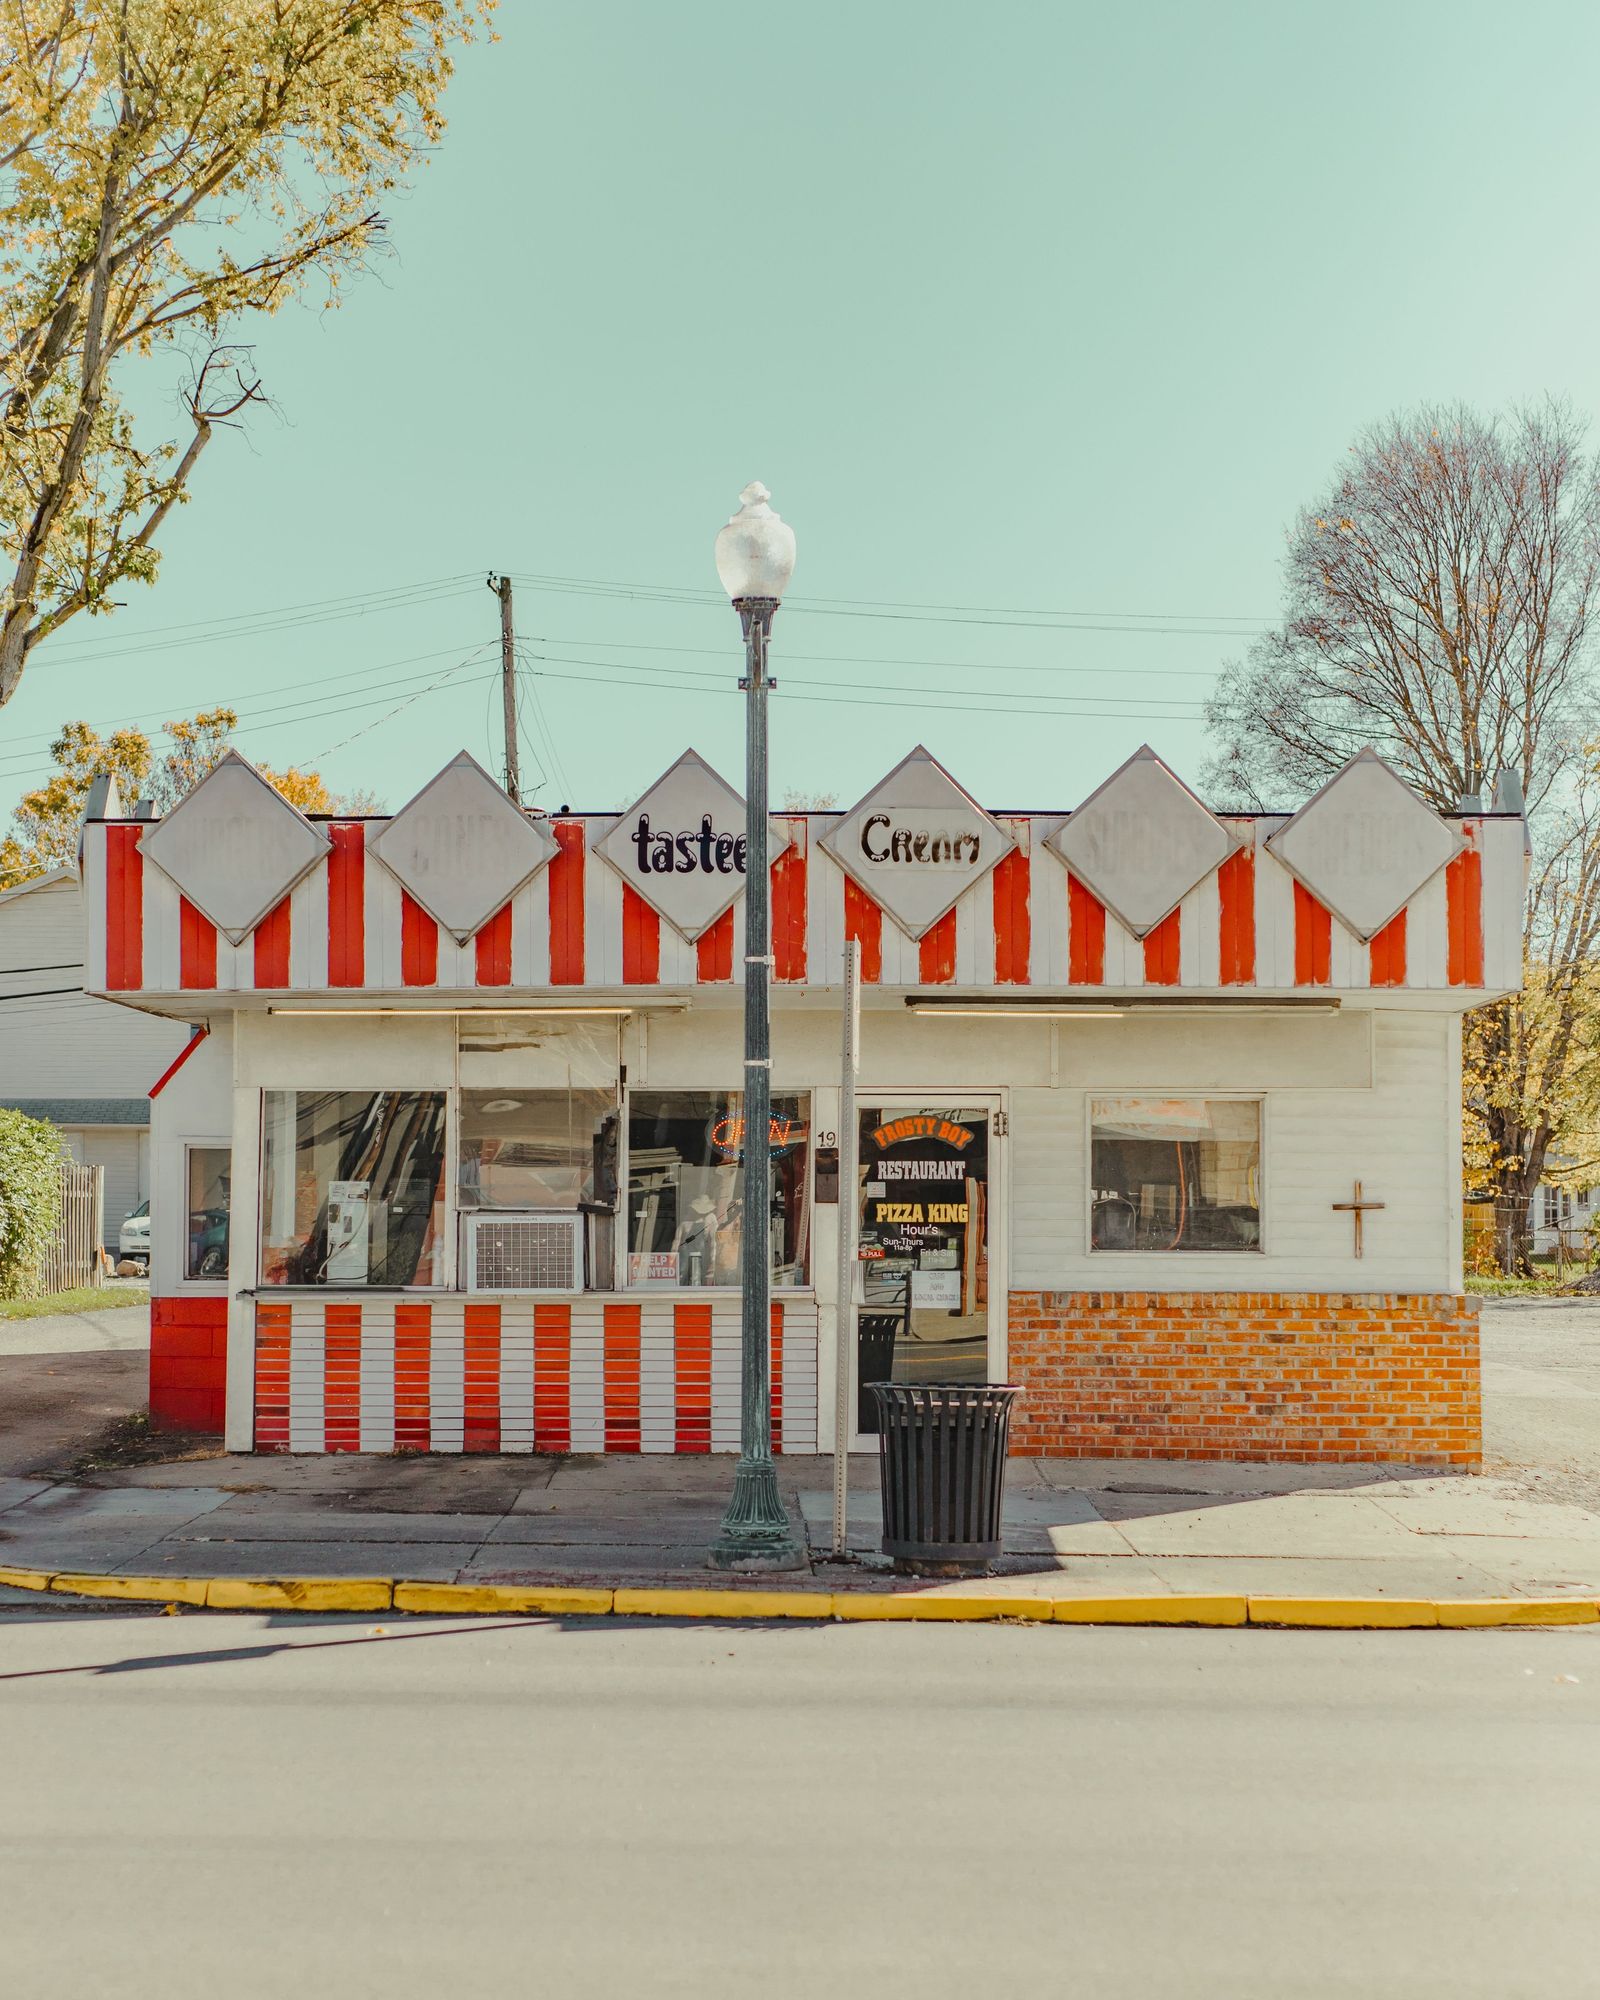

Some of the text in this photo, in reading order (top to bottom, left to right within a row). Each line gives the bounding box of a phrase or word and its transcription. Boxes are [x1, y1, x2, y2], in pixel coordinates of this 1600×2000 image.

[631, 813, 747, 874] tastee
[817, 1131, 836, 1147] 19
[873, 1117, 972, 1148] FROSTY BOY
[877, 1160, 966, 1180] RESTAURANT
[876, 1203, 969, 1223] PIZZA KING
[900, 1223, 939, 1235] Hour's
[882, 1237, 924, 1246] Sun-Thurs
